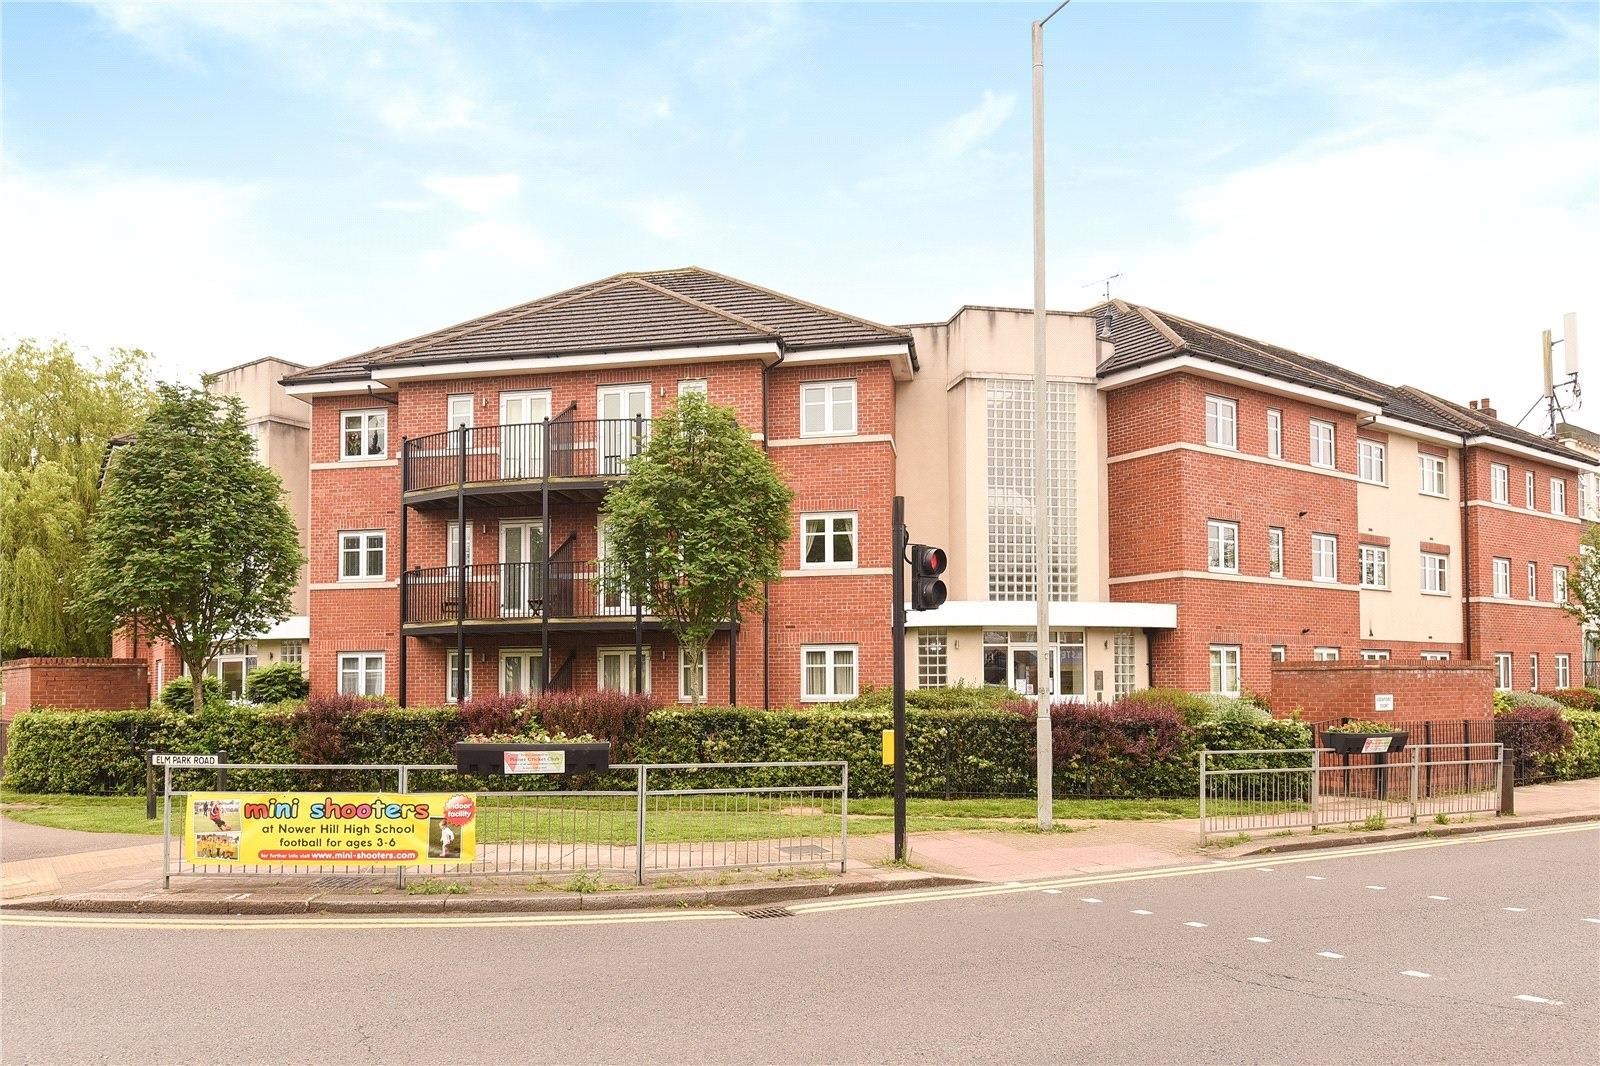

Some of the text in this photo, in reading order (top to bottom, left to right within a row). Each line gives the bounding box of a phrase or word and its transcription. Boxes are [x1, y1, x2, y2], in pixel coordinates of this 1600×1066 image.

[156, 756, 216, 765] ELM PARK ROAD
[244, 797, 430, 820] mini shooters
[447, 810, 472, 819] facility
[262, 823, 415, 836] at Nower Hill High School
[279, 837, 396, 849] football for ages 3-6
[311, 851, 416, 860] www.mini-shooters.com
